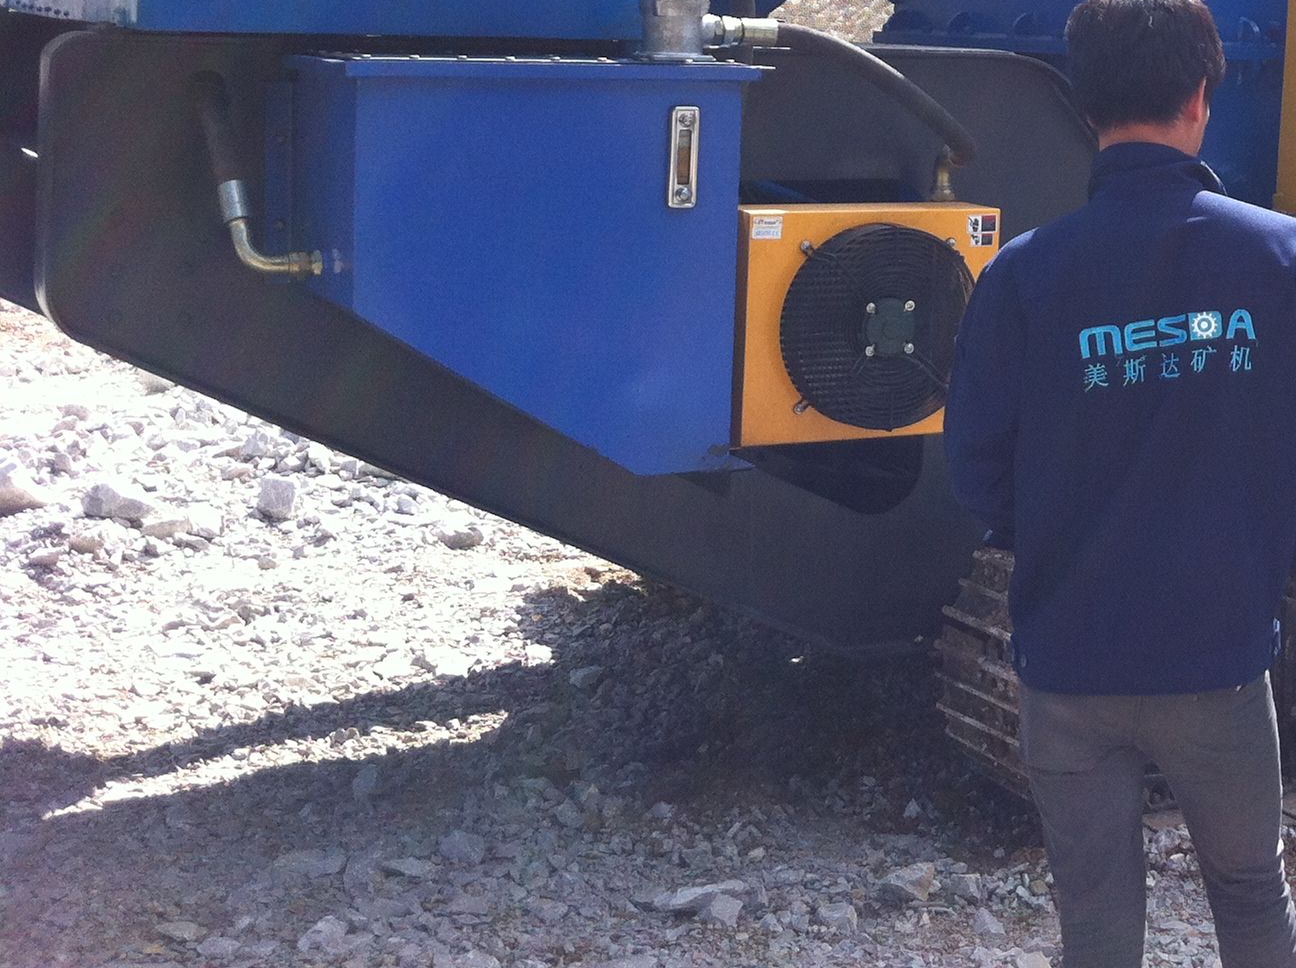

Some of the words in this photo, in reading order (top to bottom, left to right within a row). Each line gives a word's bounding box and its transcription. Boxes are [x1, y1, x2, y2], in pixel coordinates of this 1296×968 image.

[1078, 308, 1256, 359] MESDA
[1082, 344, 1252, 392] 美斯达矿机
